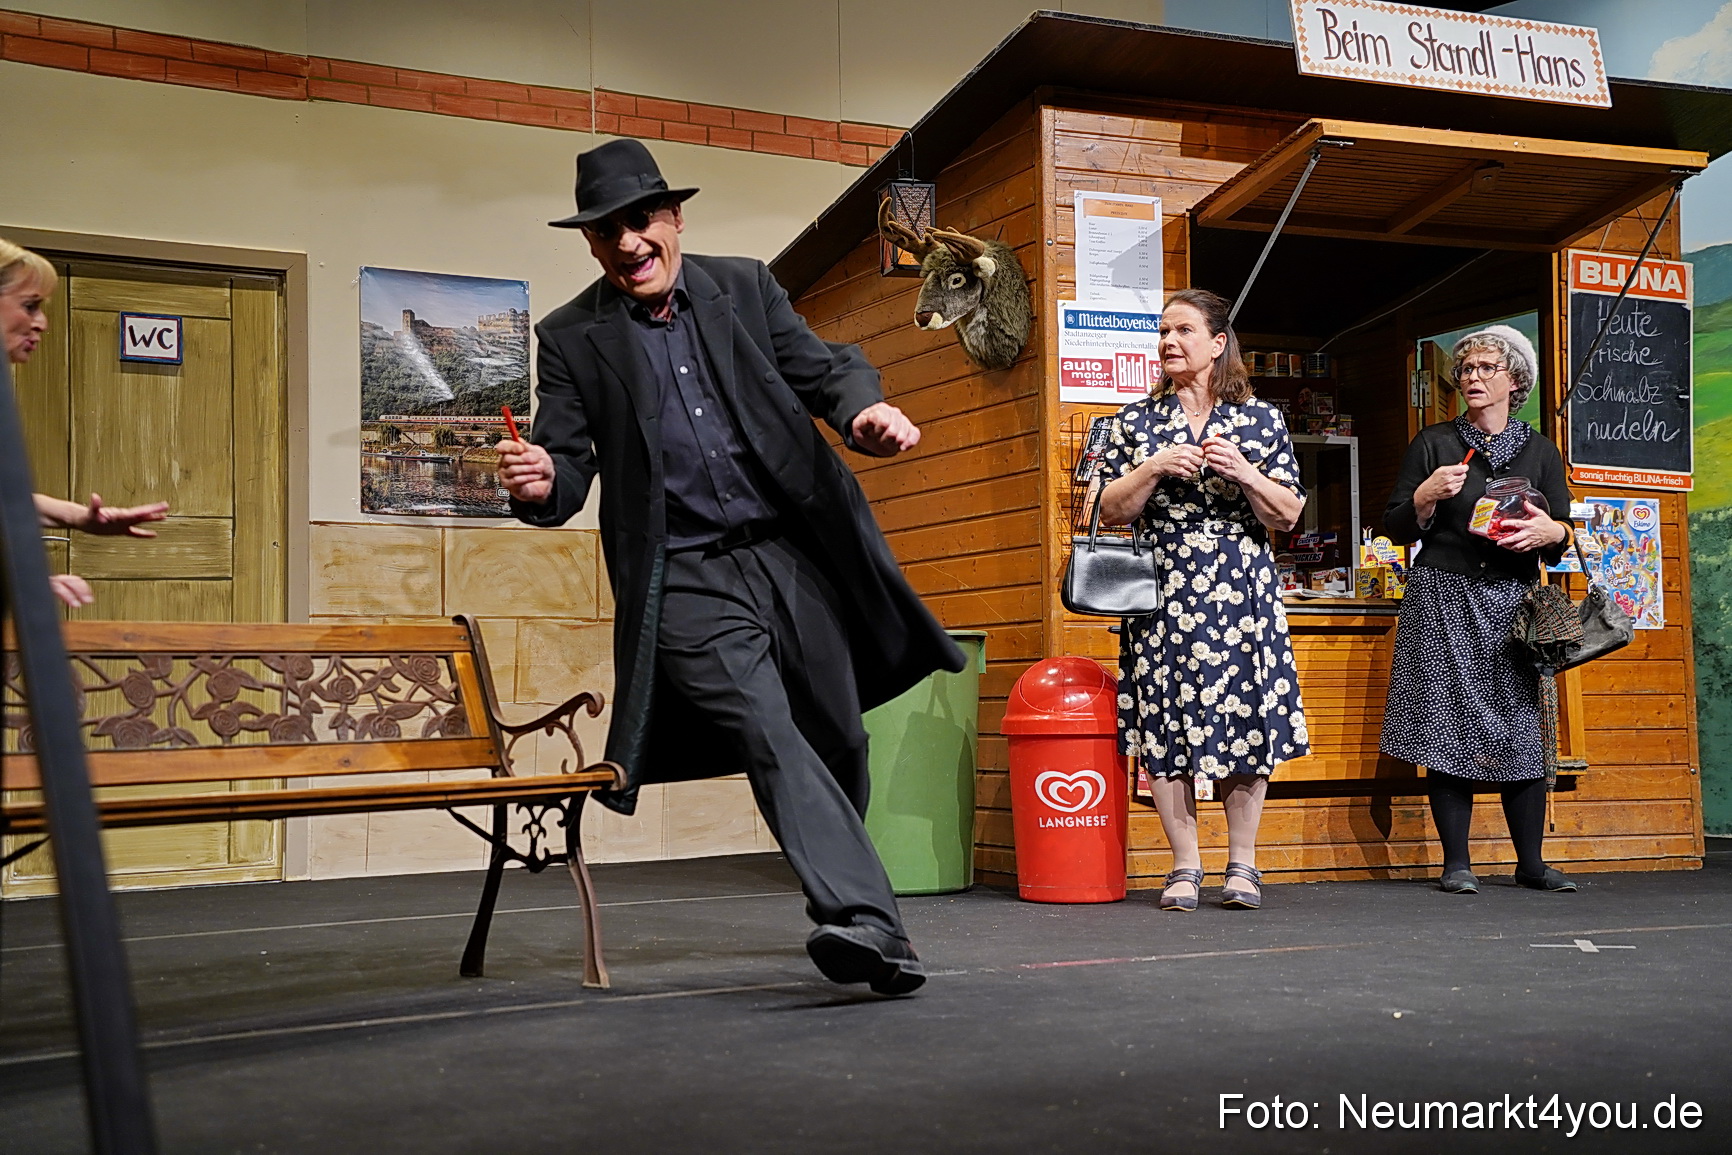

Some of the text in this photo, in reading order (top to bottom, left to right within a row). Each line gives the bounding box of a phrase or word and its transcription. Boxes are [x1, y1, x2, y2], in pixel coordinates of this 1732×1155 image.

[1315, 7, 1392, 68] Beim
[1579, 259, 1684, 294] BLUNA
[1596, 298, 1663, 338] Heute
[128, 324, 174, 350] WC
[1064, 330, 1108, 339] Stadtanzeiger
[1062, 360, 1103, 371] auto
[1117, 355, 1145, 388] Bild
[1071, 371, 1110, 379] motor
[1085, 379, 1114, 387] sport
[1576, 372, 1665, 405] Schmalz
[1587, 406, 1681, 443] nudeln
[1580, 471, 1684, 486] sonnig fruchtig BLUNA-frisch
[1633, 520, 1651, 528] Eskimo
[1293, 552, 1322, 562] NICKERS
[1039, 815, 1107, 828] LANGNESE
